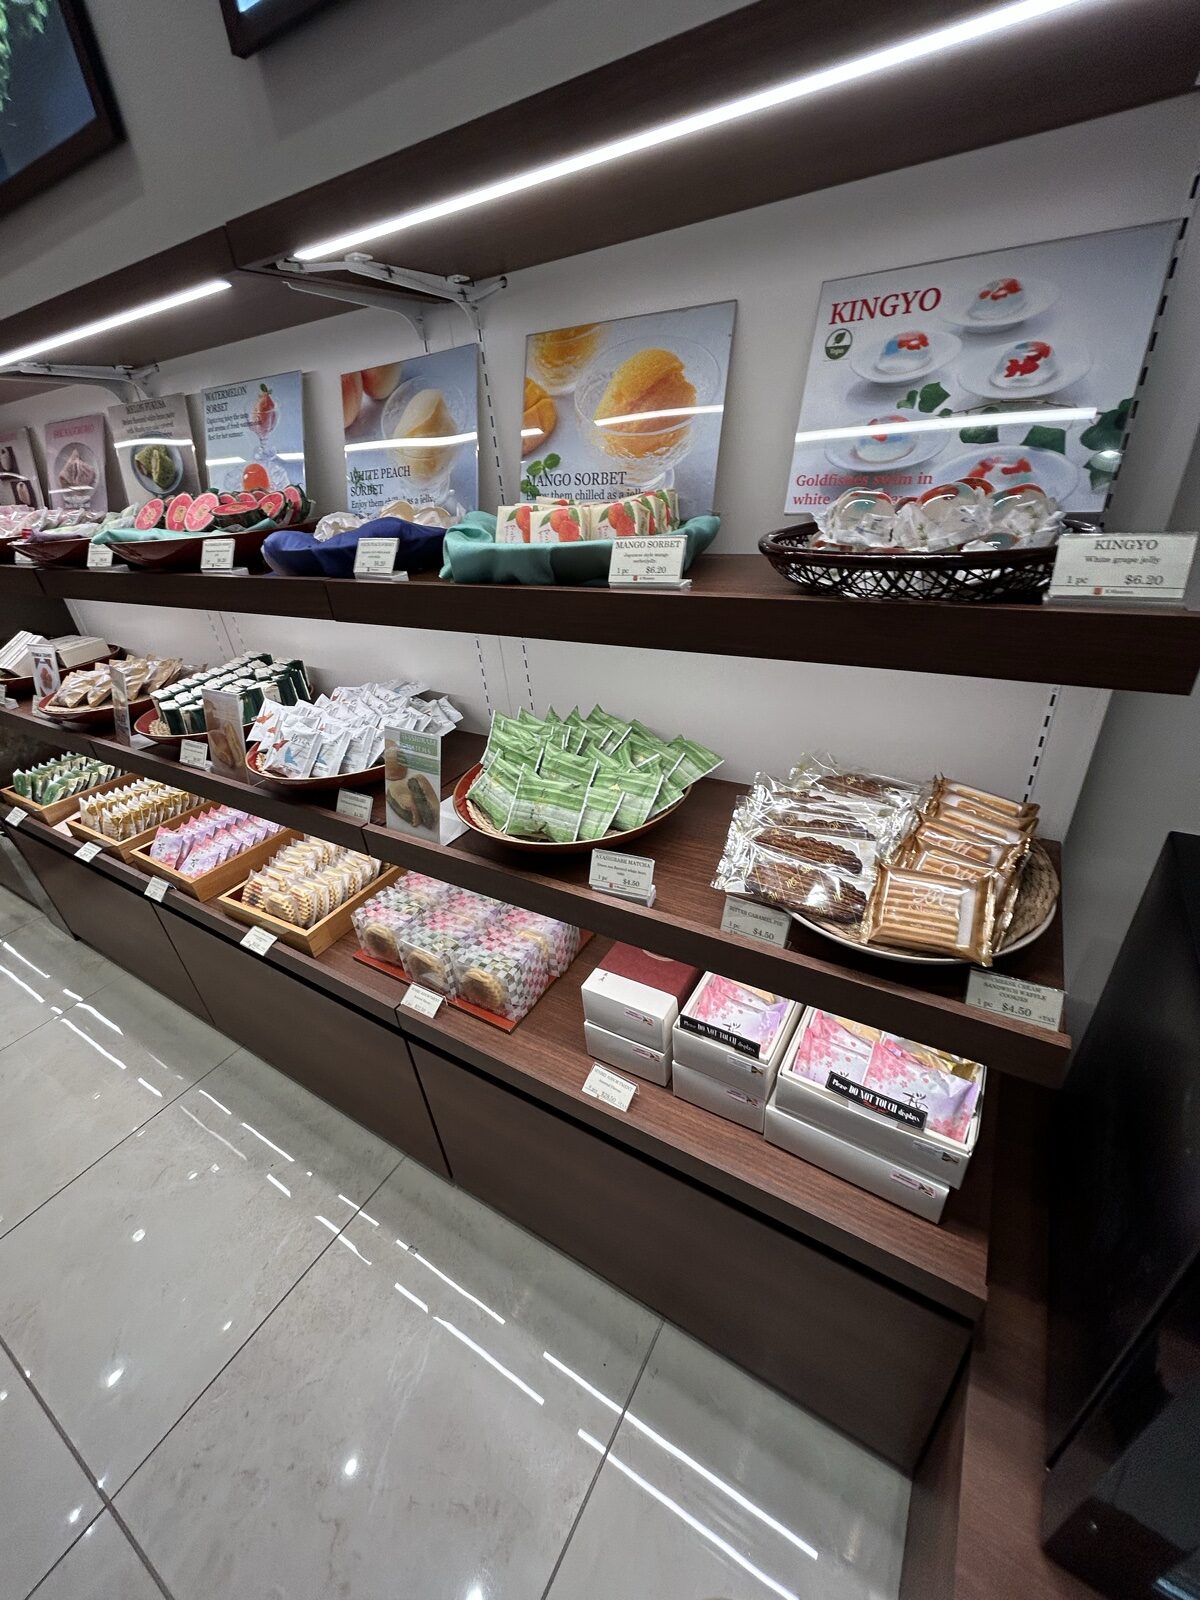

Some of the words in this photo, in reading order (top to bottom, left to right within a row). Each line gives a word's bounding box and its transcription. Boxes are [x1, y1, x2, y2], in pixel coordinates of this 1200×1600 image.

[828, 287, 942, 325] KINGYO
[204, 385, 247, 402] WATERMELON
[206, 402, 229, 415] SORBET
[349, 468, 379, 482] WHITE
[381, 465, 411, 479] PEACH
[526, 472, 572, 487] MANGO
[574, 471, 627, 486] SORBET
[796, 473, 868, 487] Goldfishes
[873, 474, 913, 486] swim
[917, 472, 933, 484] in
[350, 483, 384, 497] SORBET
[550, 490, 573, 500] them
[575, 489, 605, 500] chilled
[607, 491, 617, 500] as
[351, 499, 368, 510] Enjoy
[368, 498, 385, 508] them
[793, 493, 830, 505] white
[616, 541, 646, 549] MANGO
[647, 540, 682, 549] SORBET
[1094, 539, 1159, 550] KINGYO
[1084, 555, 1111, 563] White
[1112, 557, 1138, 565] grape
[1139, 555, 1161, 565] jelly
[646, 566, 667, 574] $6.20
[1066, 575, 1072, 584] 1
[1075, 576, 1089, 586] pc
[1124, 574, 1164, 586] $6.20
[628, 860, 650, 868] MATCHA
[623, 879, 639, 887] $4.50
[729, 906, 747, 915] BITTER
[748, 912, 772, 923] CARAMEL
[753, 928, 774, 939] $4.50
[984, 983, 1018, 994] SANDWICH
[1020, 991, 1047, 1000] WAFFLE
[1018, 984, 1041, 992] CREAM
[1000, 993, 1028, 1002] COOKIES
[983, 1000, 994, 1008] pc
[1002, 1002, 1032, 1017] $4.50
[697, 1023, 706, 1031] DO
[706, 1026, 718, 1037] NOT
[719, 1031, 738, 1045] TOUCH
[831, 1078, 848, 1091] Please
[848, 1085, 859, 1096] DO
[859, 1089, 875, 1106] NOT
[875, 1096, 898, 1114] TOUCH
[898, 1108, 921, 1123] displays
